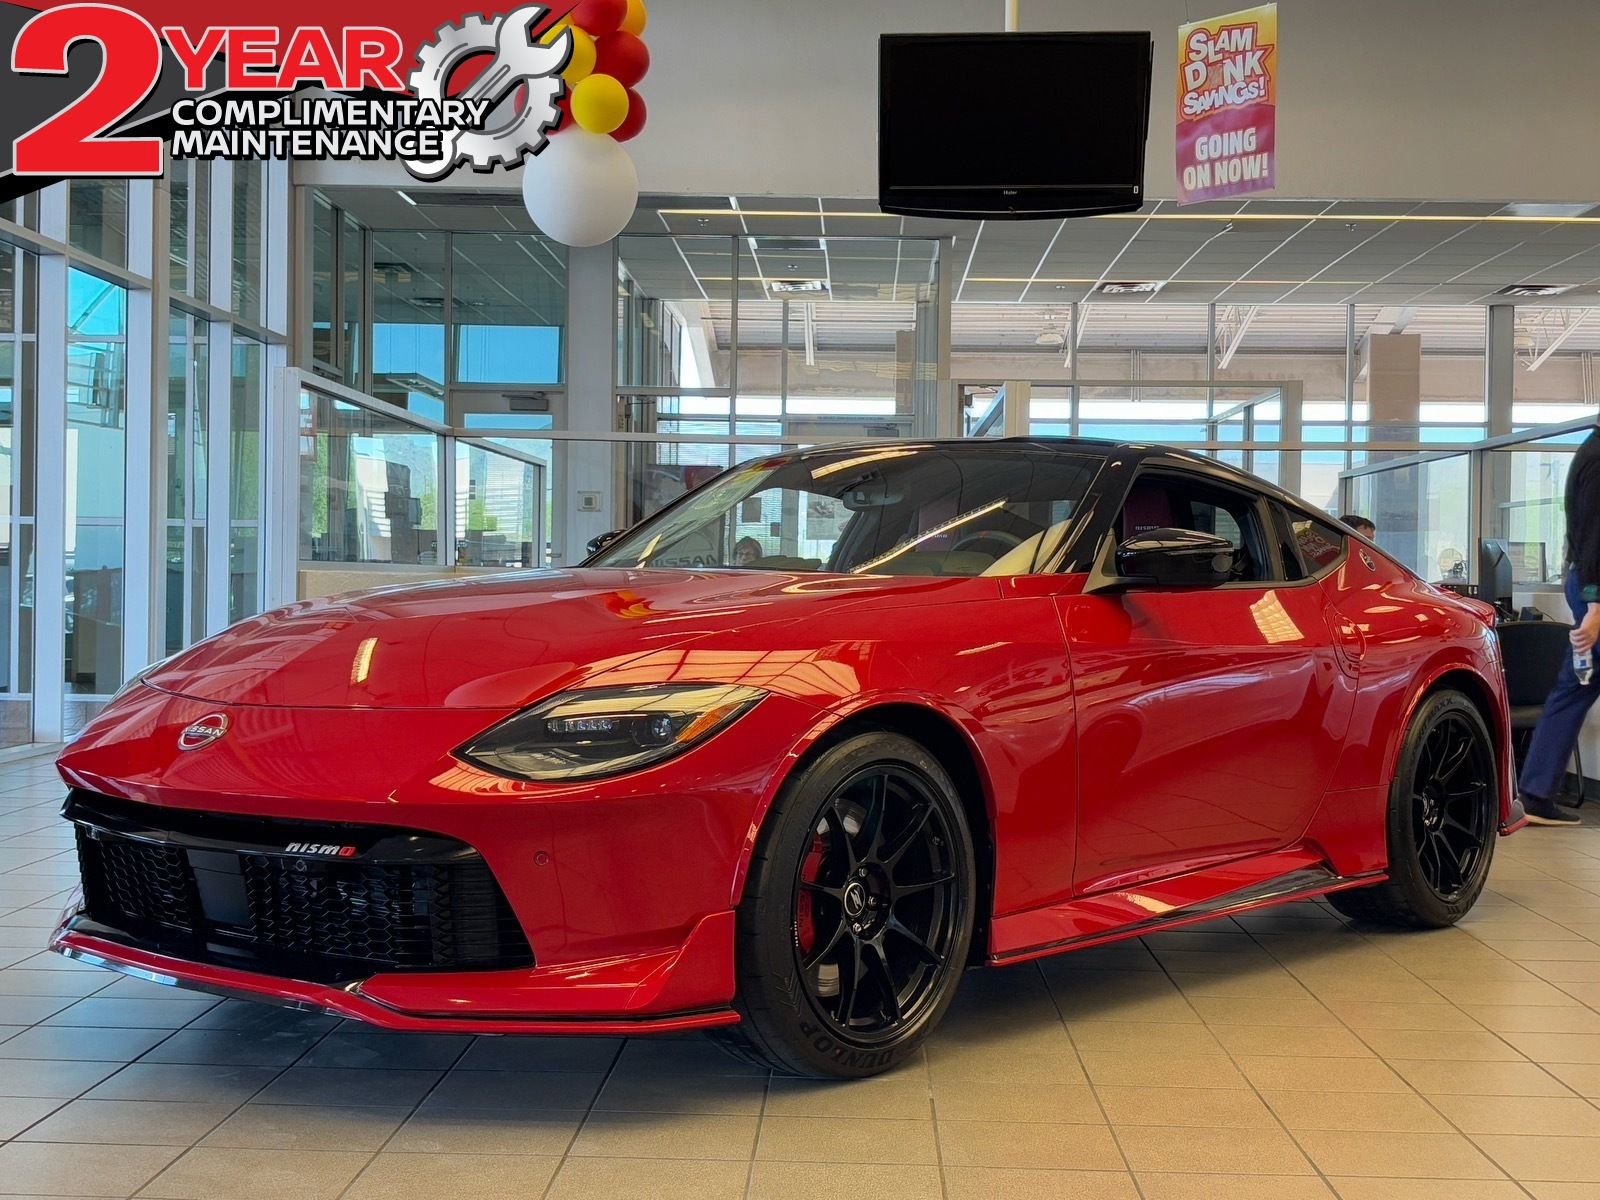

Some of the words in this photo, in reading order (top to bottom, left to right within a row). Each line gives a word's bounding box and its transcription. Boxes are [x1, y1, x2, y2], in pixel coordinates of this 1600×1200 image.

[1188, 27, 1253, 64] SLAM
[1184, 50, 1264, 91] DNK
[1195, 127, 1256, 161] GOING
[1183, 164, 1211, 191] ON
[1214, 152, 1269, 186] NOW!
[799, 1021, 896, 1069] DUNLOP
